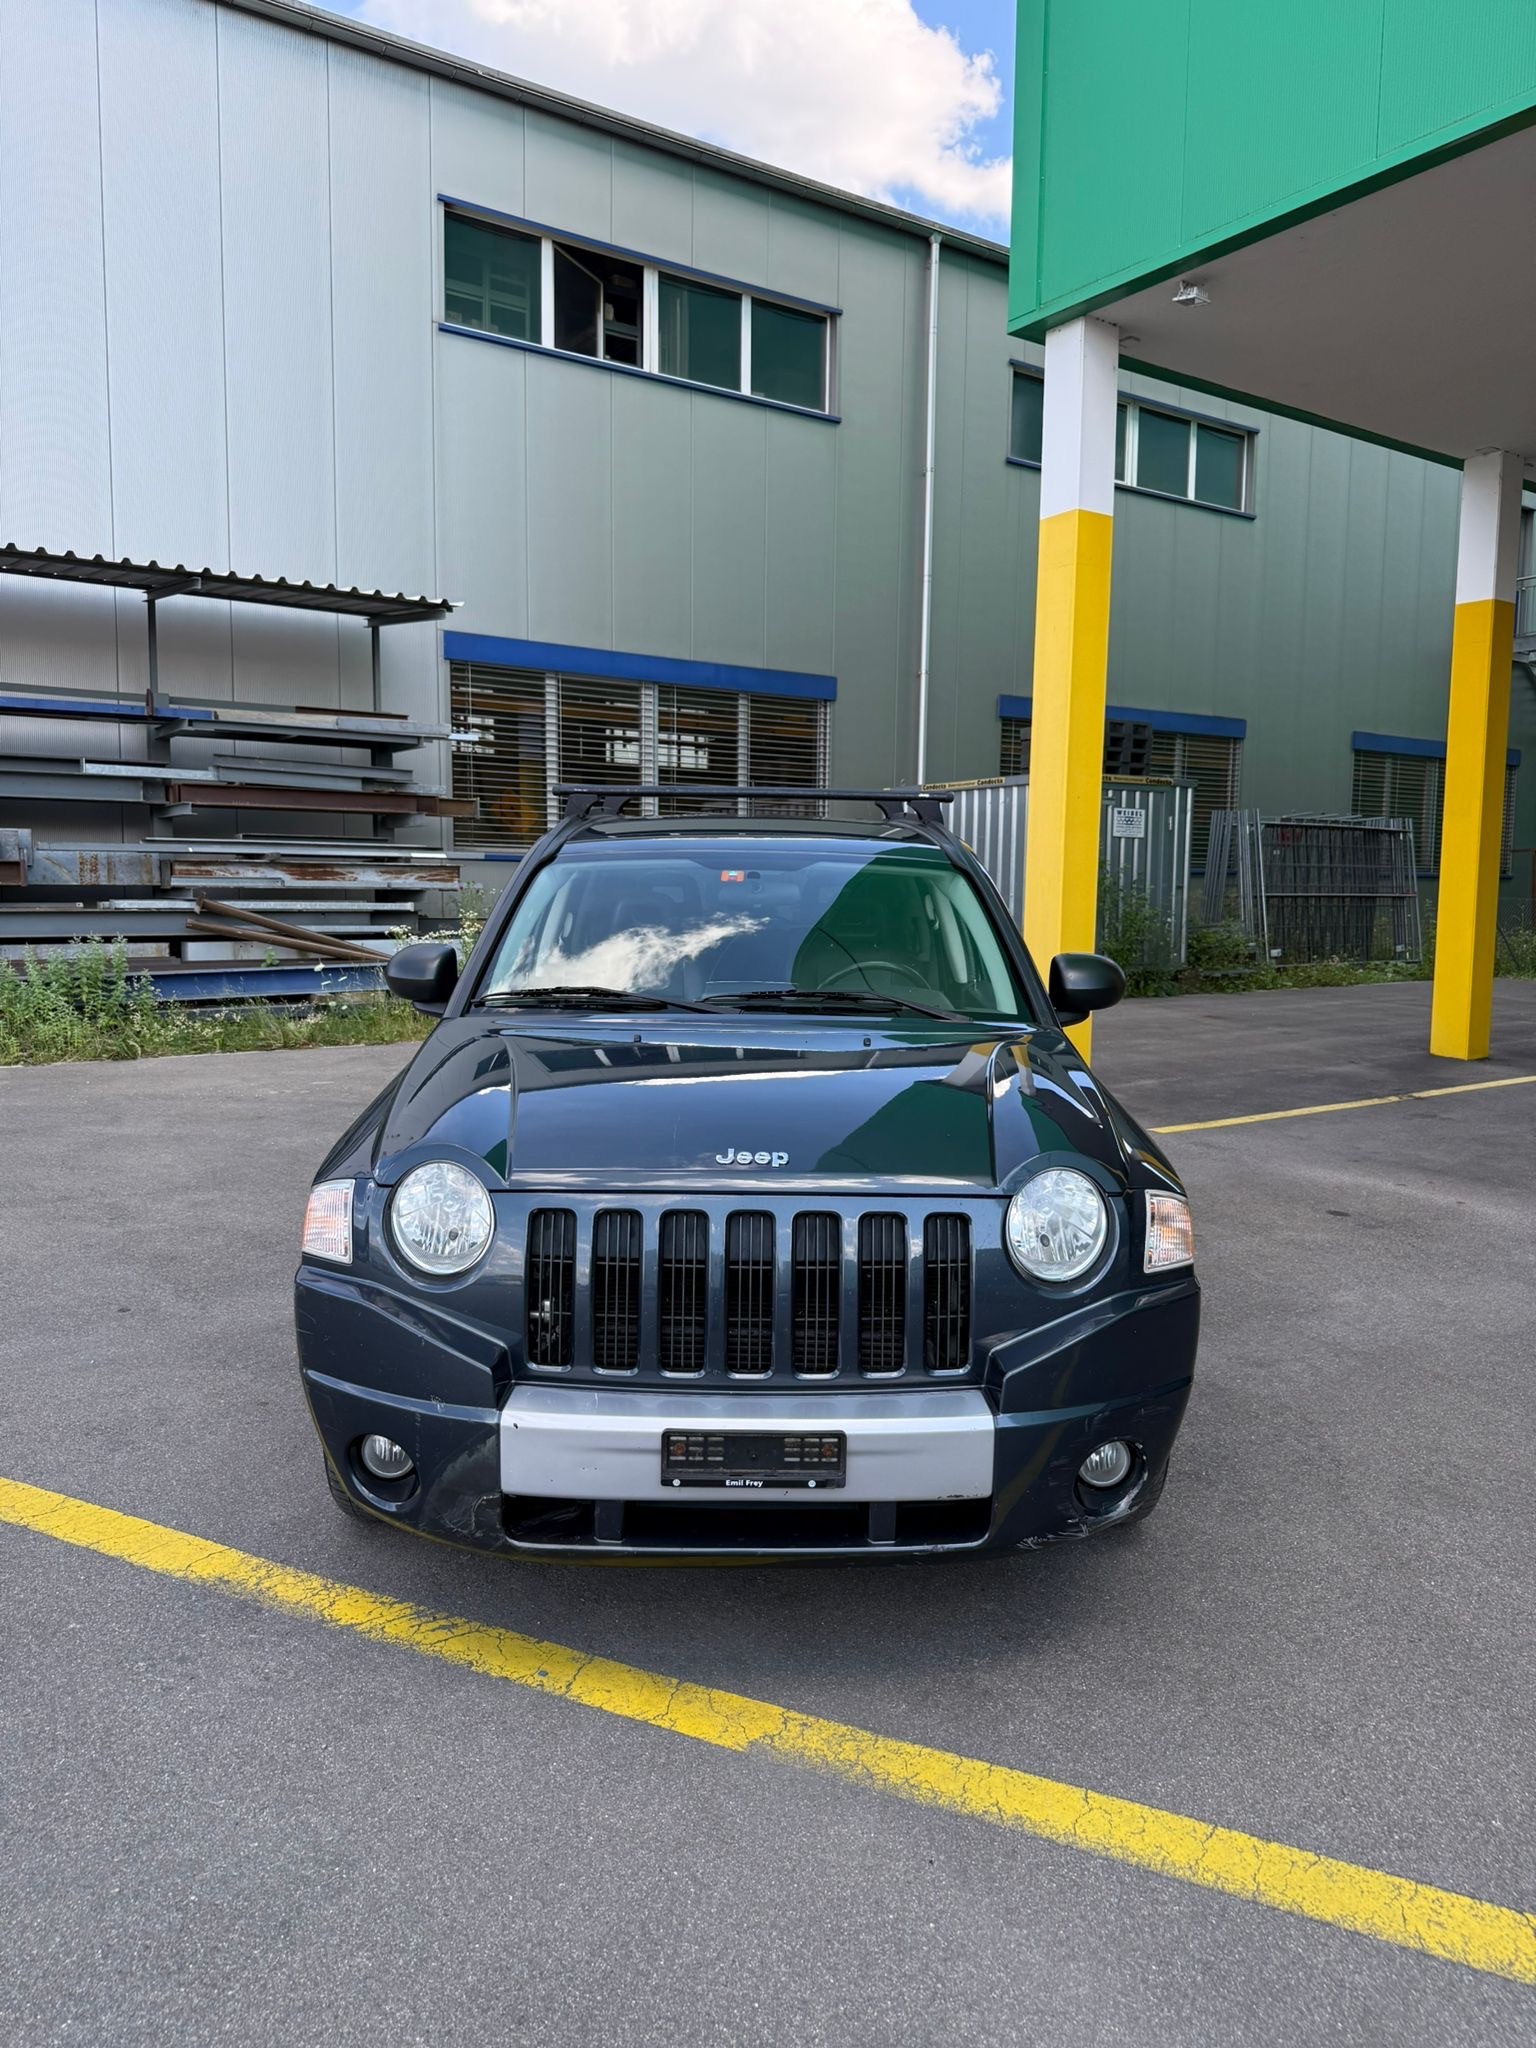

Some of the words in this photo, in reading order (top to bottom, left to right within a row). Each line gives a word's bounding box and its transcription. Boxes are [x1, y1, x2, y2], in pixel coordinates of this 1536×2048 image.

[715, 1148, 789, 1167] Jeep
[725, 1479, 744, 1487] Emil
[745, 1480, 764, 1488] Frey
